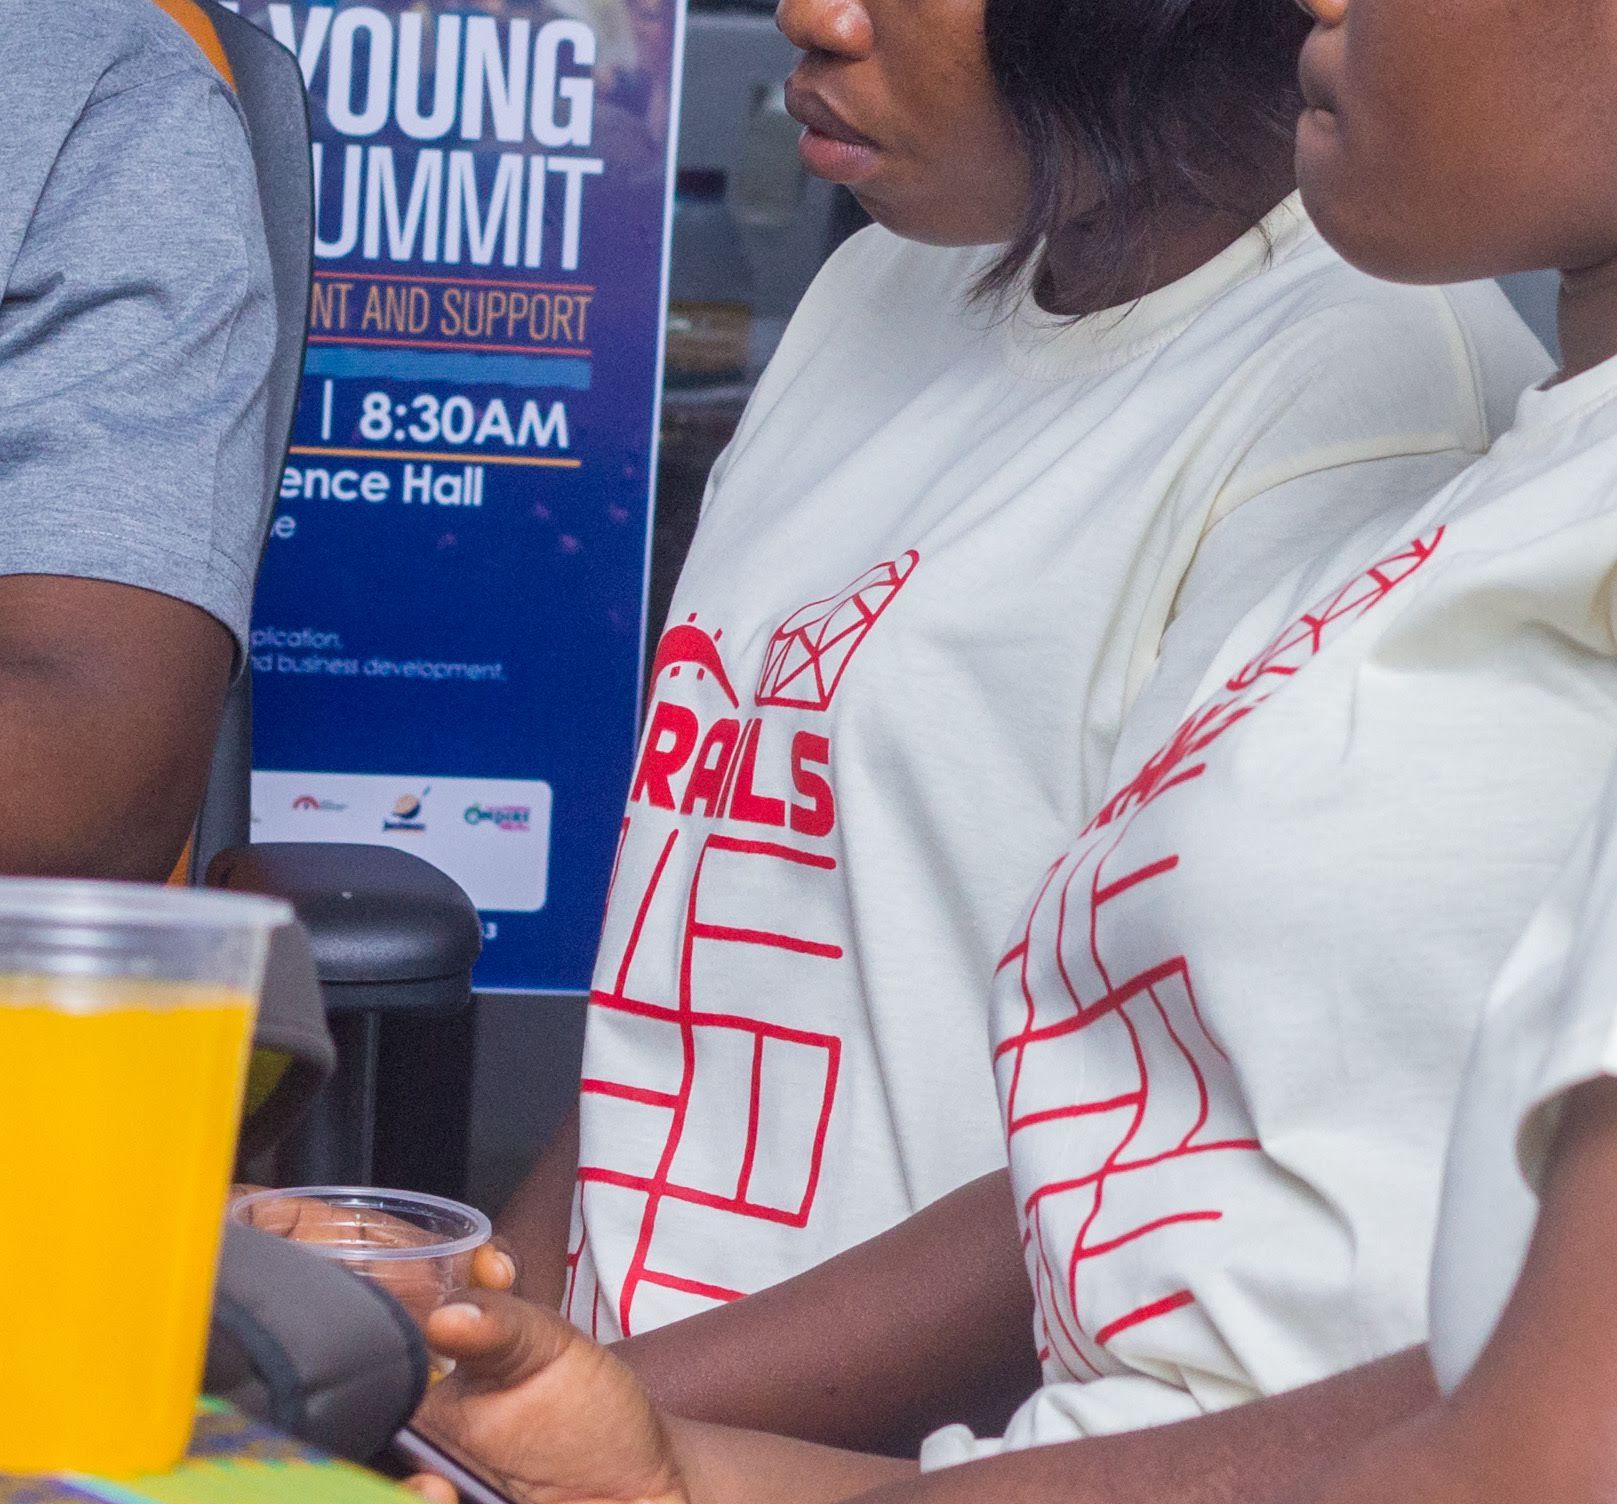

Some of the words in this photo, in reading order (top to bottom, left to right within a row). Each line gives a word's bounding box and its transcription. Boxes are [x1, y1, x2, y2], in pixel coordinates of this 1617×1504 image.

[268, 3, 597, 148] YOUNG
[361, 286, 431, 336] AND
[440, 288, 593, 343] SUPPORT
[358, 391, 570, 450] 8:30AM
[280, 465, 391, 503] ence
[402, 464, 484, 507] Hall
